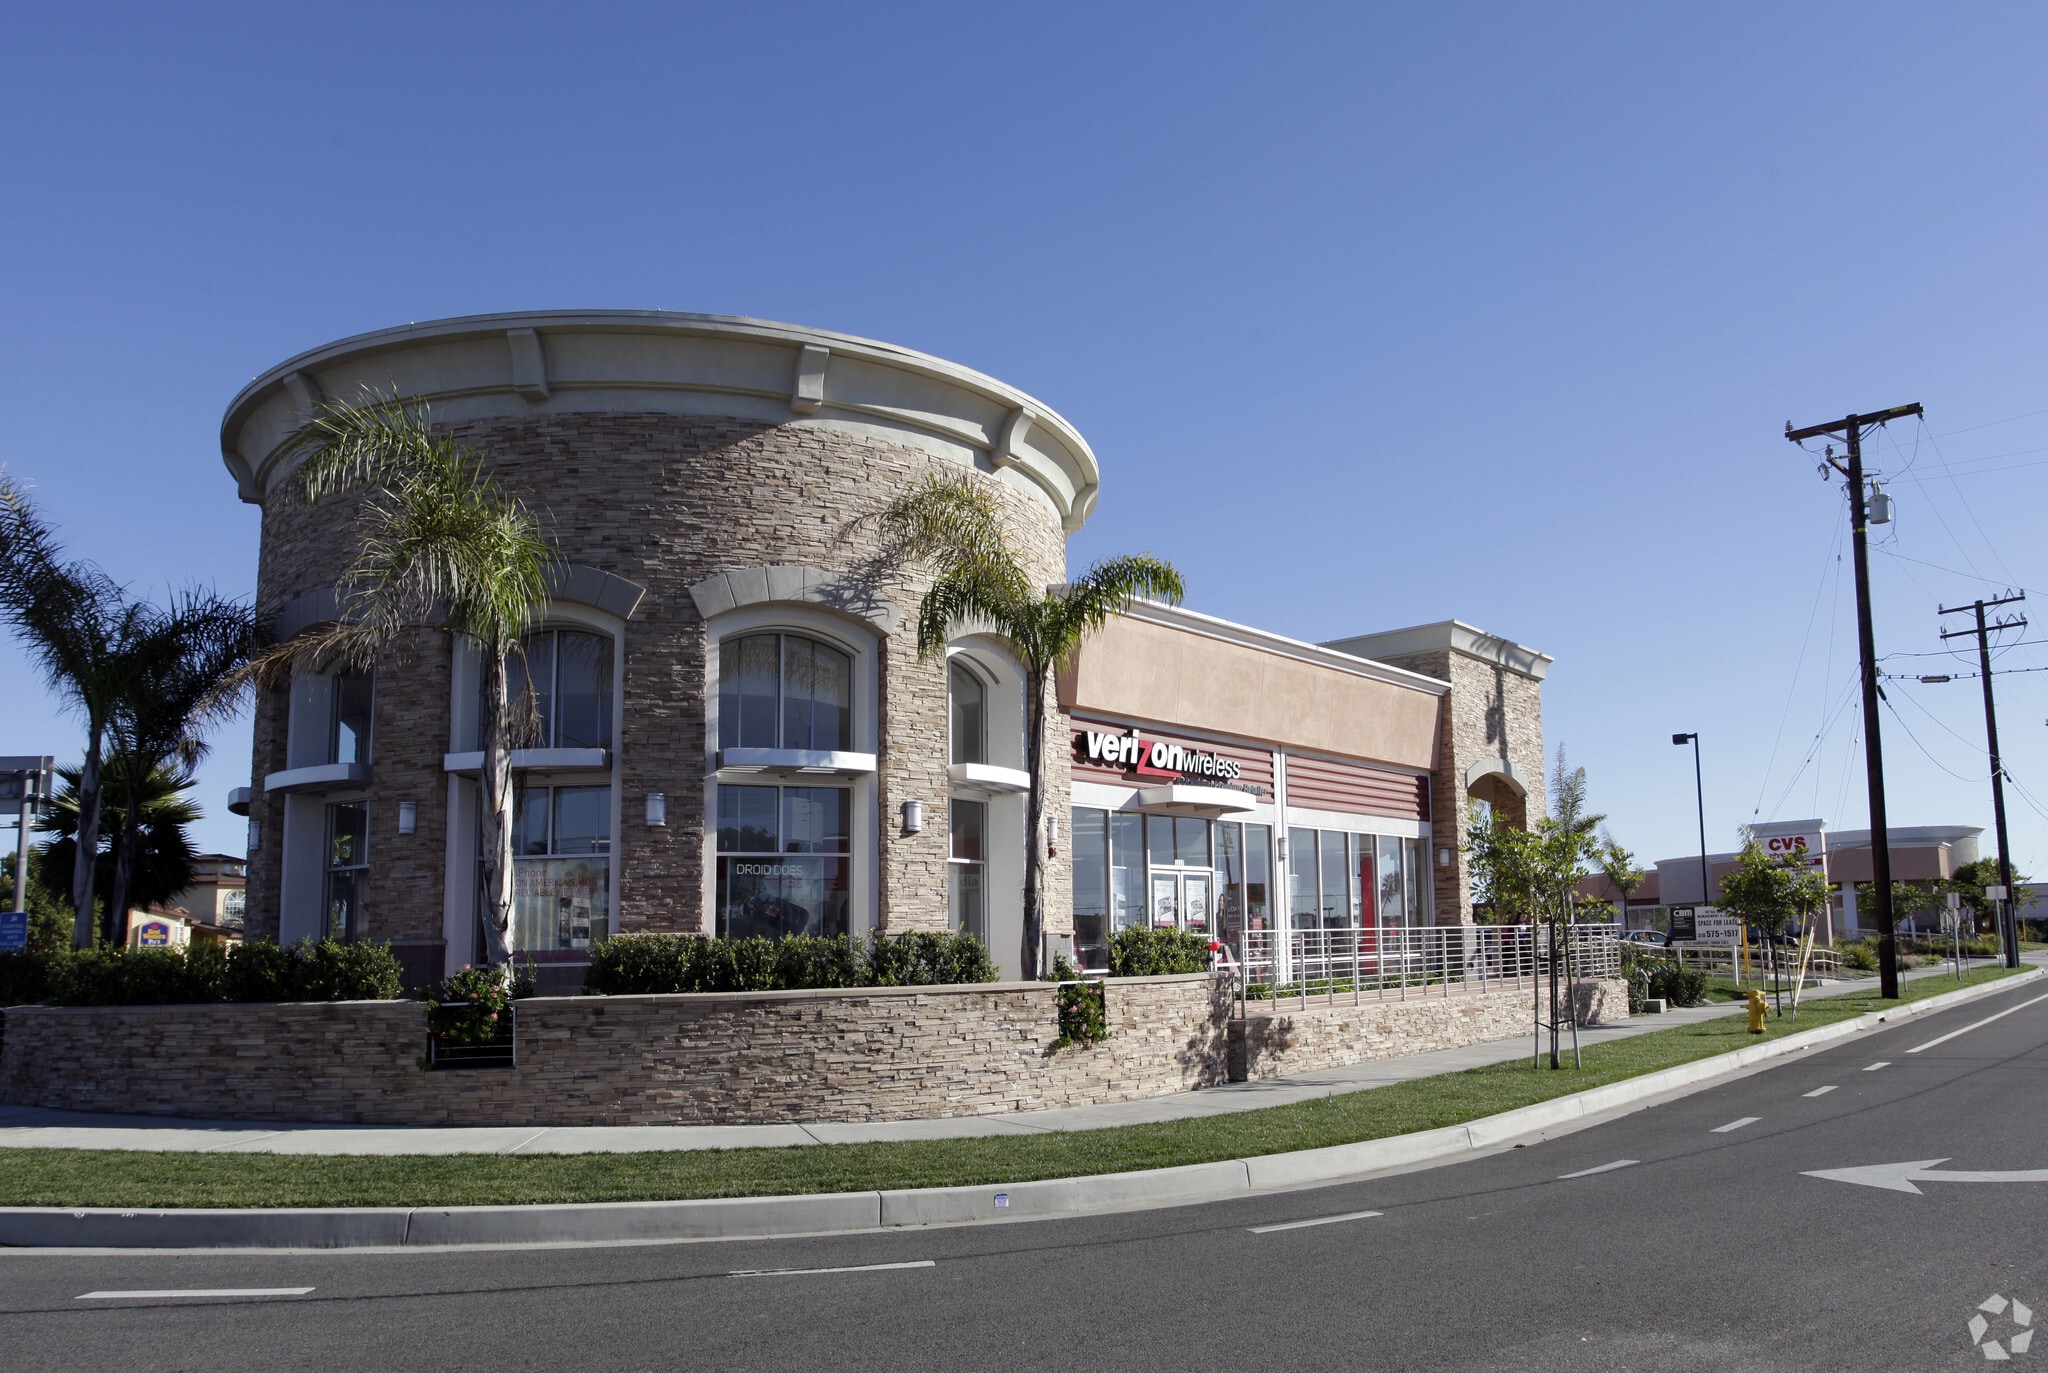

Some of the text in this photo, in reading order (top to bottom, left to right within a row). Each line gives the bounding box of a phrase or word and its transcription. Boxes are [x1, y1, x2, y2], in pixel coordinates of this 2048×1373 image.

[1086, 728, 1241, 780] verizon wireless
[1768, 836, 1806, 851] CVS
[515, 867, 548, 878] iPhone
[736, 863, 804, 876] DROID DOES
[515, 878, 528, 888] ON
[515, 888, 555, 897] RELIABLE
[1673, 909, 1693, 917] CBM
[1706, 929, 1739, 938] 575-1517
